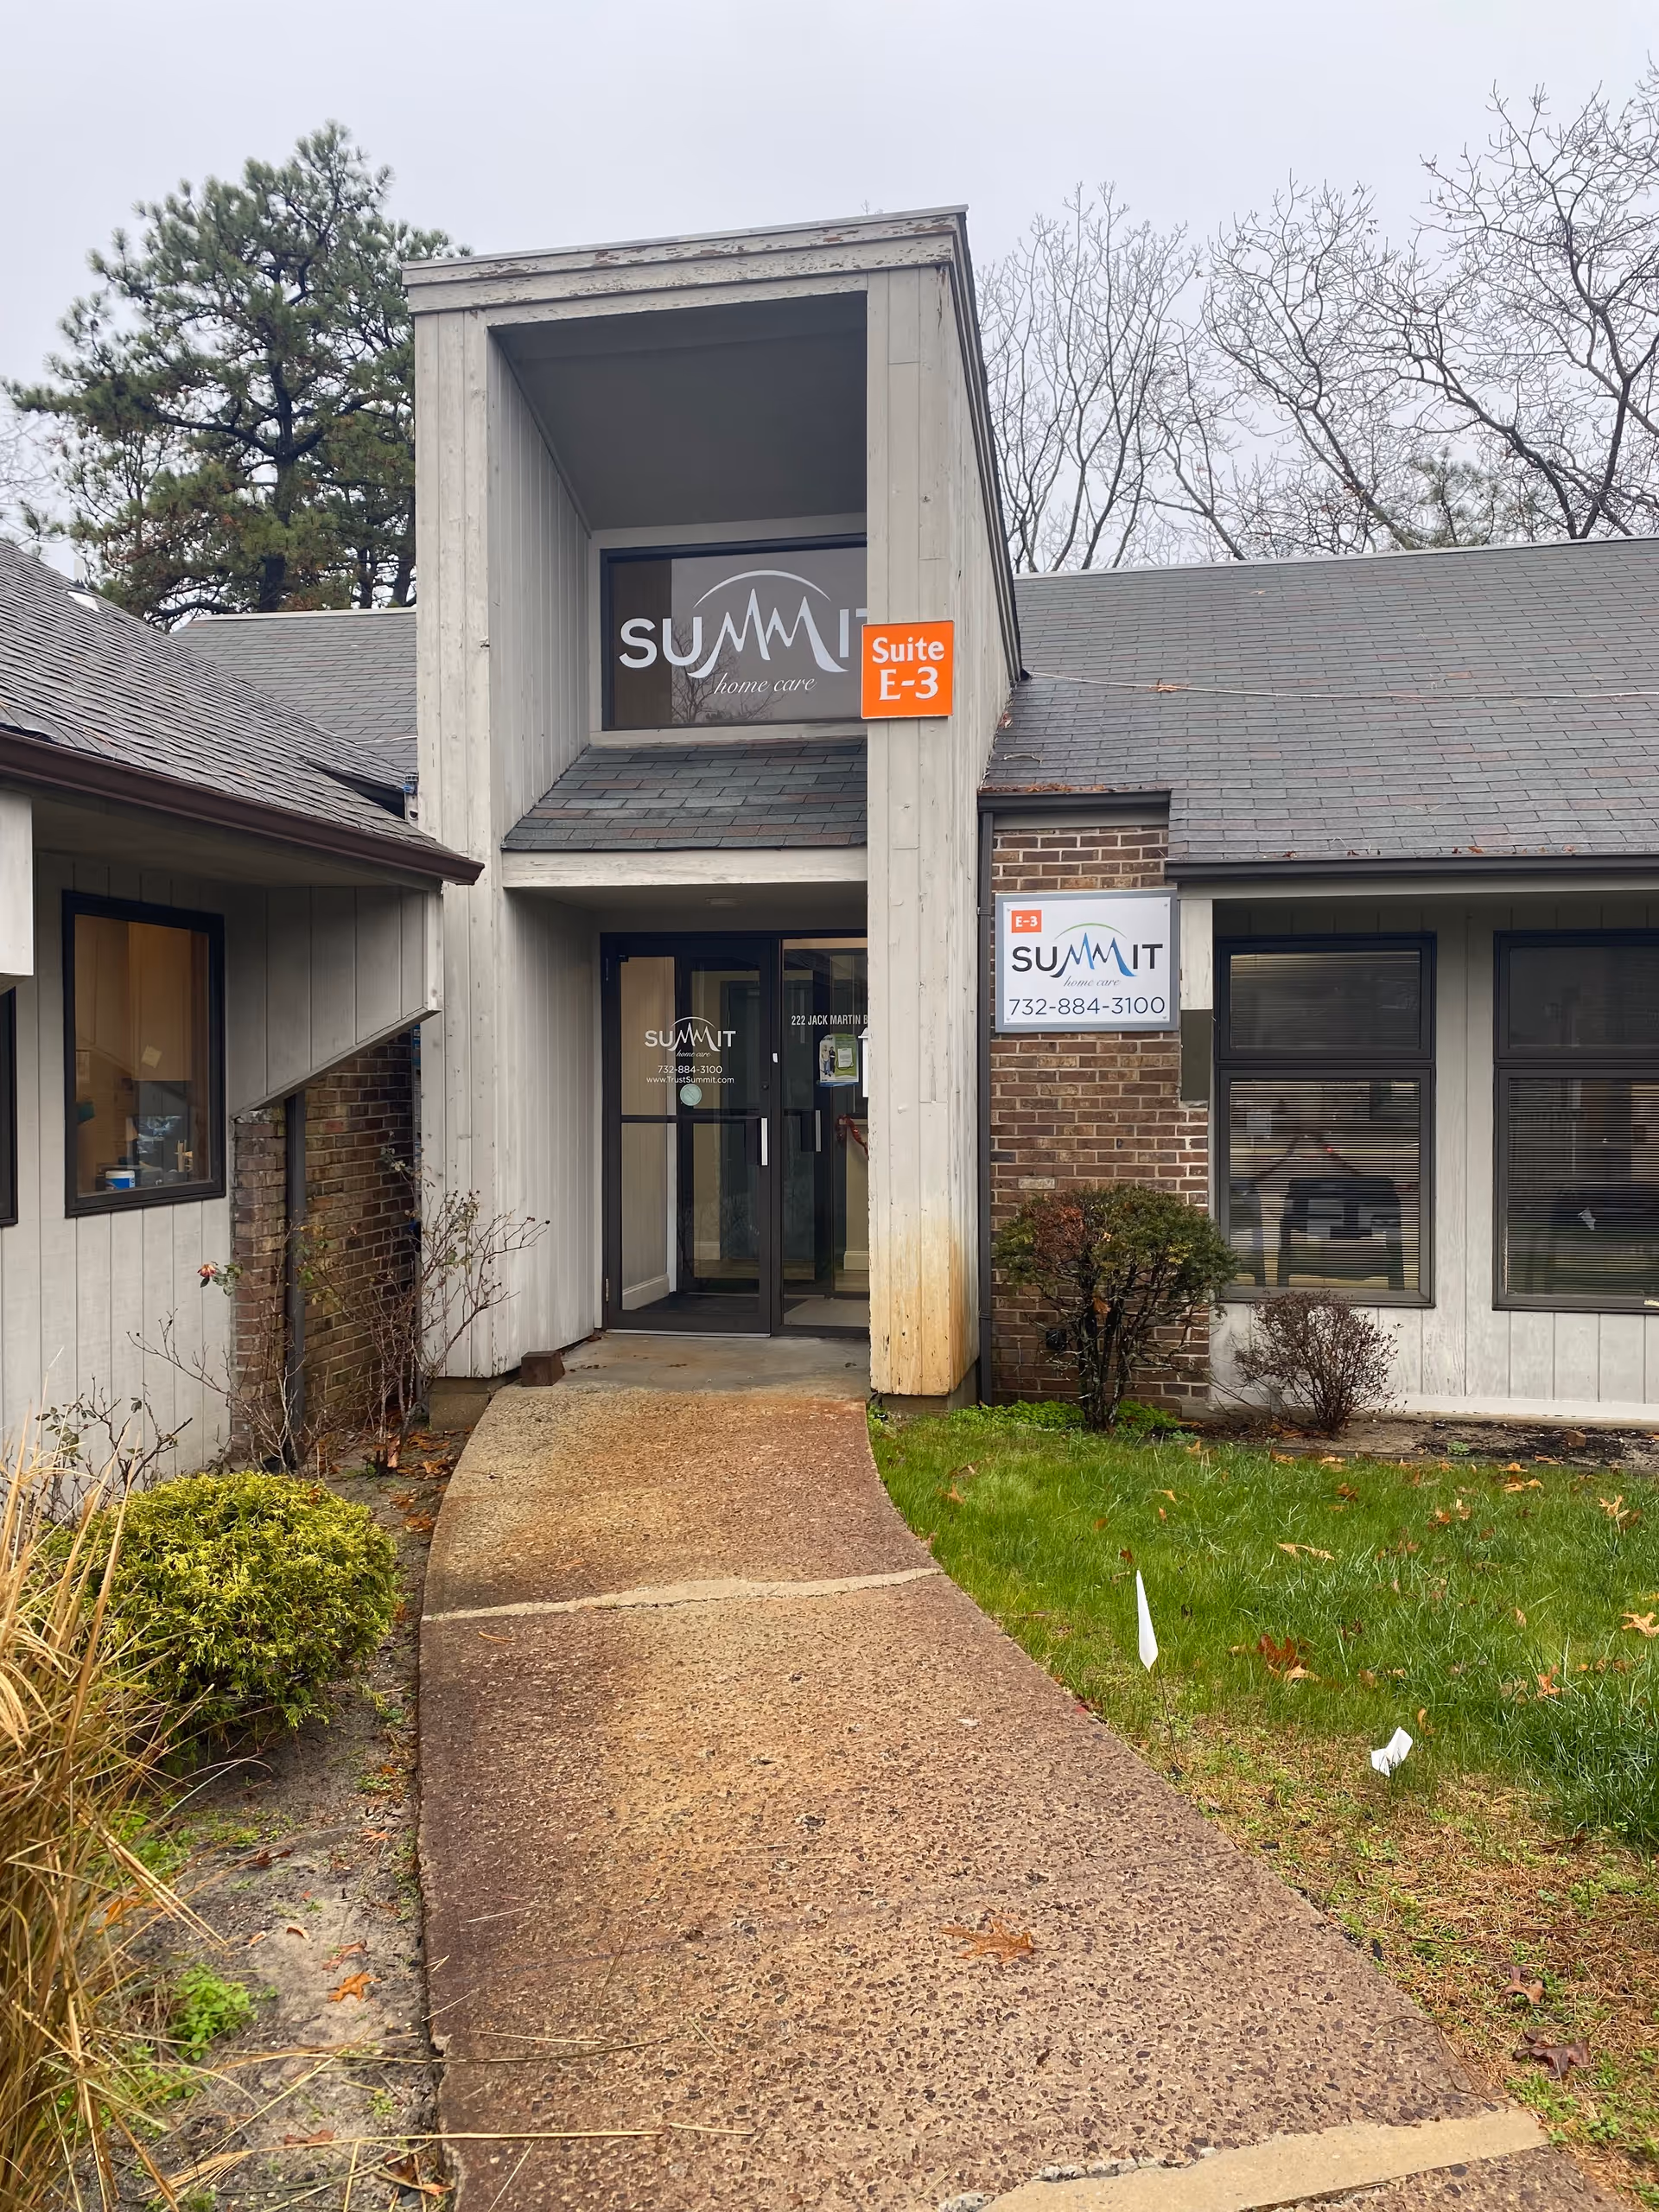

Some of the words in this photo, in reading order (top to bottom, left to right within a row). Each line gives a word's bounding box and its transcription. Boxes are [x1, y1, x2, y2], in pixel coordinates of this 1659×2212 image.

[871, 637, 945, 664] Suite
[713, 672, 772, 695] home
[772, 677, 817, 692] care
[879, 666, 938, 701] E-3
[1015, 916, 1038, 927] E-3
[1012, 932, 1163, 978] SUMMIT
[1063, 976, 1094, 988] home
[1096, 978, 1122, 987] care
[1008, 996, 1166, 1016] 732-884-3100
[791, 1014, 806, 1026] 222
[807, 1014, 828, 1026] JACK
[830, 1014, 861, 1025] MARTIN
[645, 1022, 736, 1052] SUMMIT
[676, 1049, 696, 1058] home
